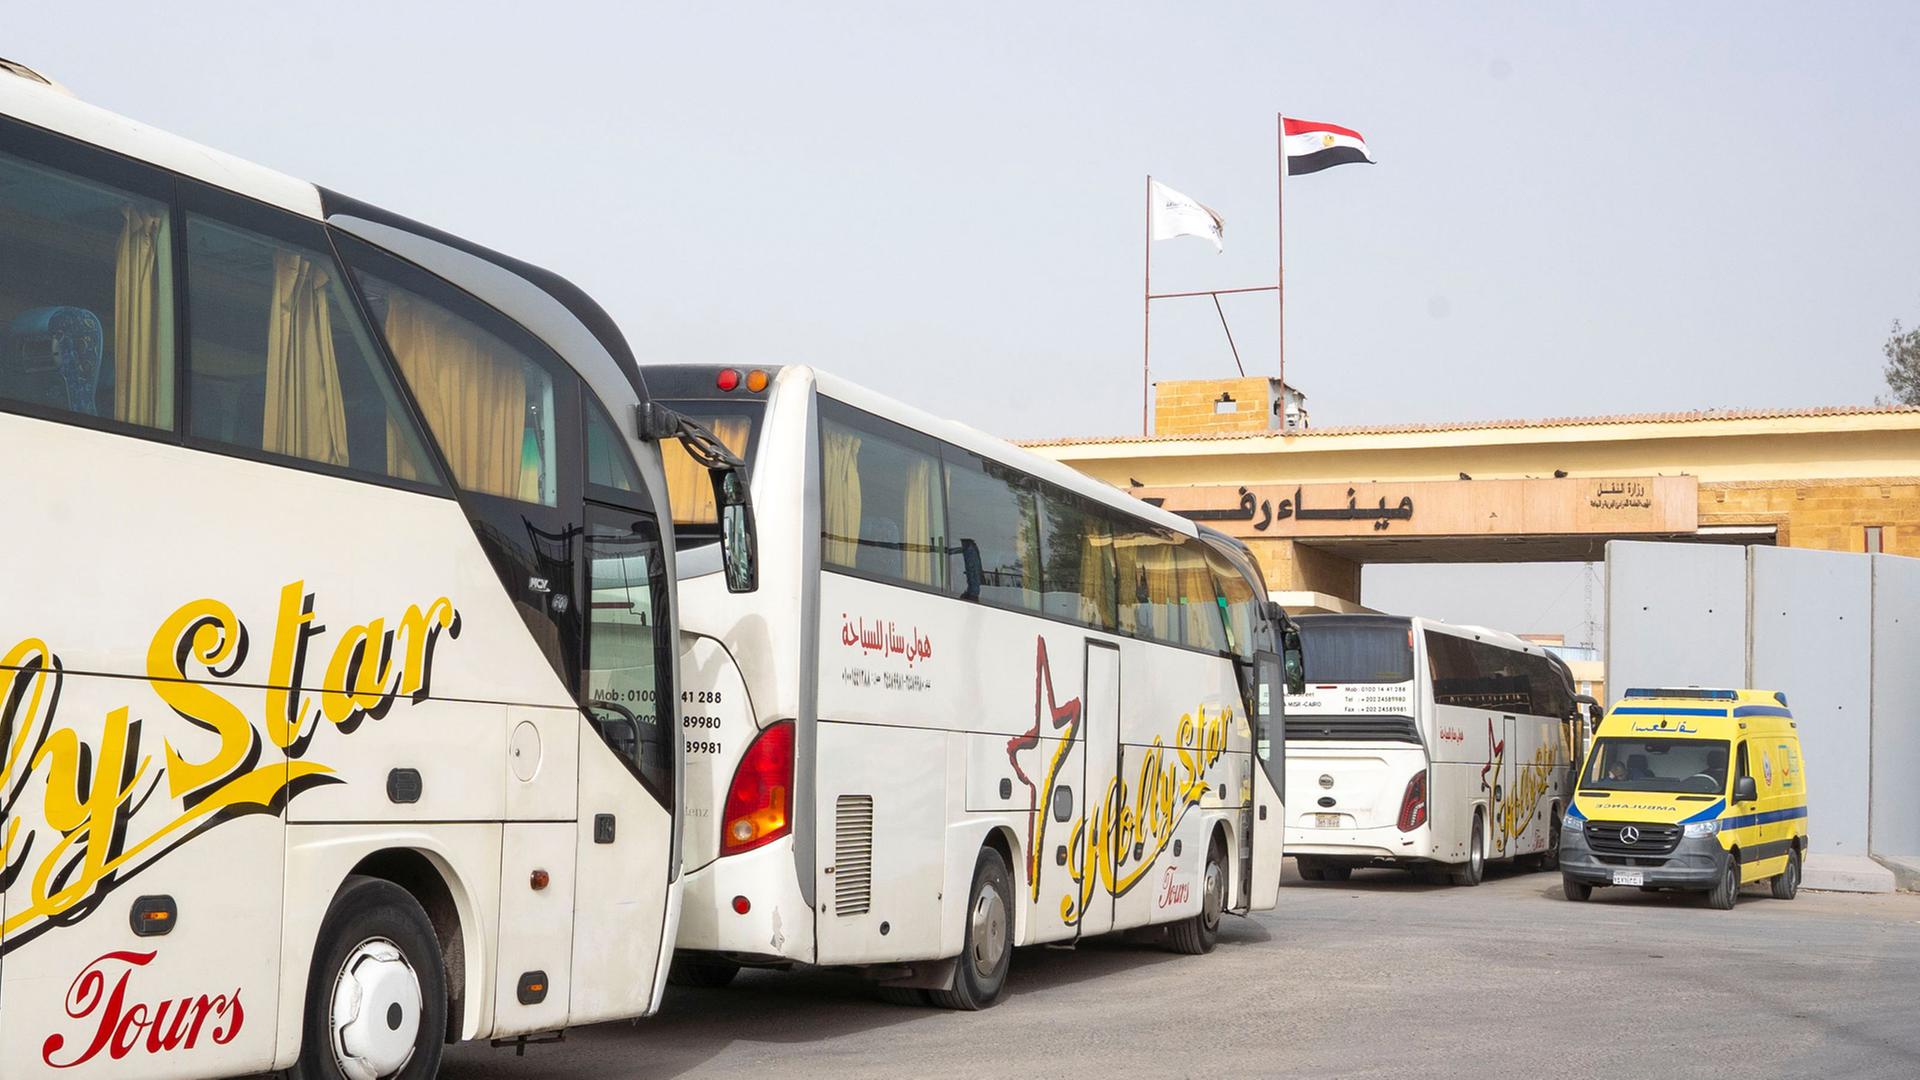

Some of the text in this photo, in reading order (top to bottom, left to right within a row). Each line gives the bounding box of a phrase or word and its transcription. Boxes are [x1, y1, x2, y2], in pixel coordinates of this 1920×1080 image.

[1277, 485, 1414, 531] ميناء
[885, 622, 904, 658] ستار
[906, 626, 931, 668] هولي
[147, 580, 461, 810] Star
[628, 690, 656, 702] 0100
[681, 691, 694, 702] 41
[698, 692, 722, 704] 288
[1060, 703, 1233, 926] Holly Star
[1159, 865, 1190, 909] Tours
[43, 950, 245, 1068] Tours
